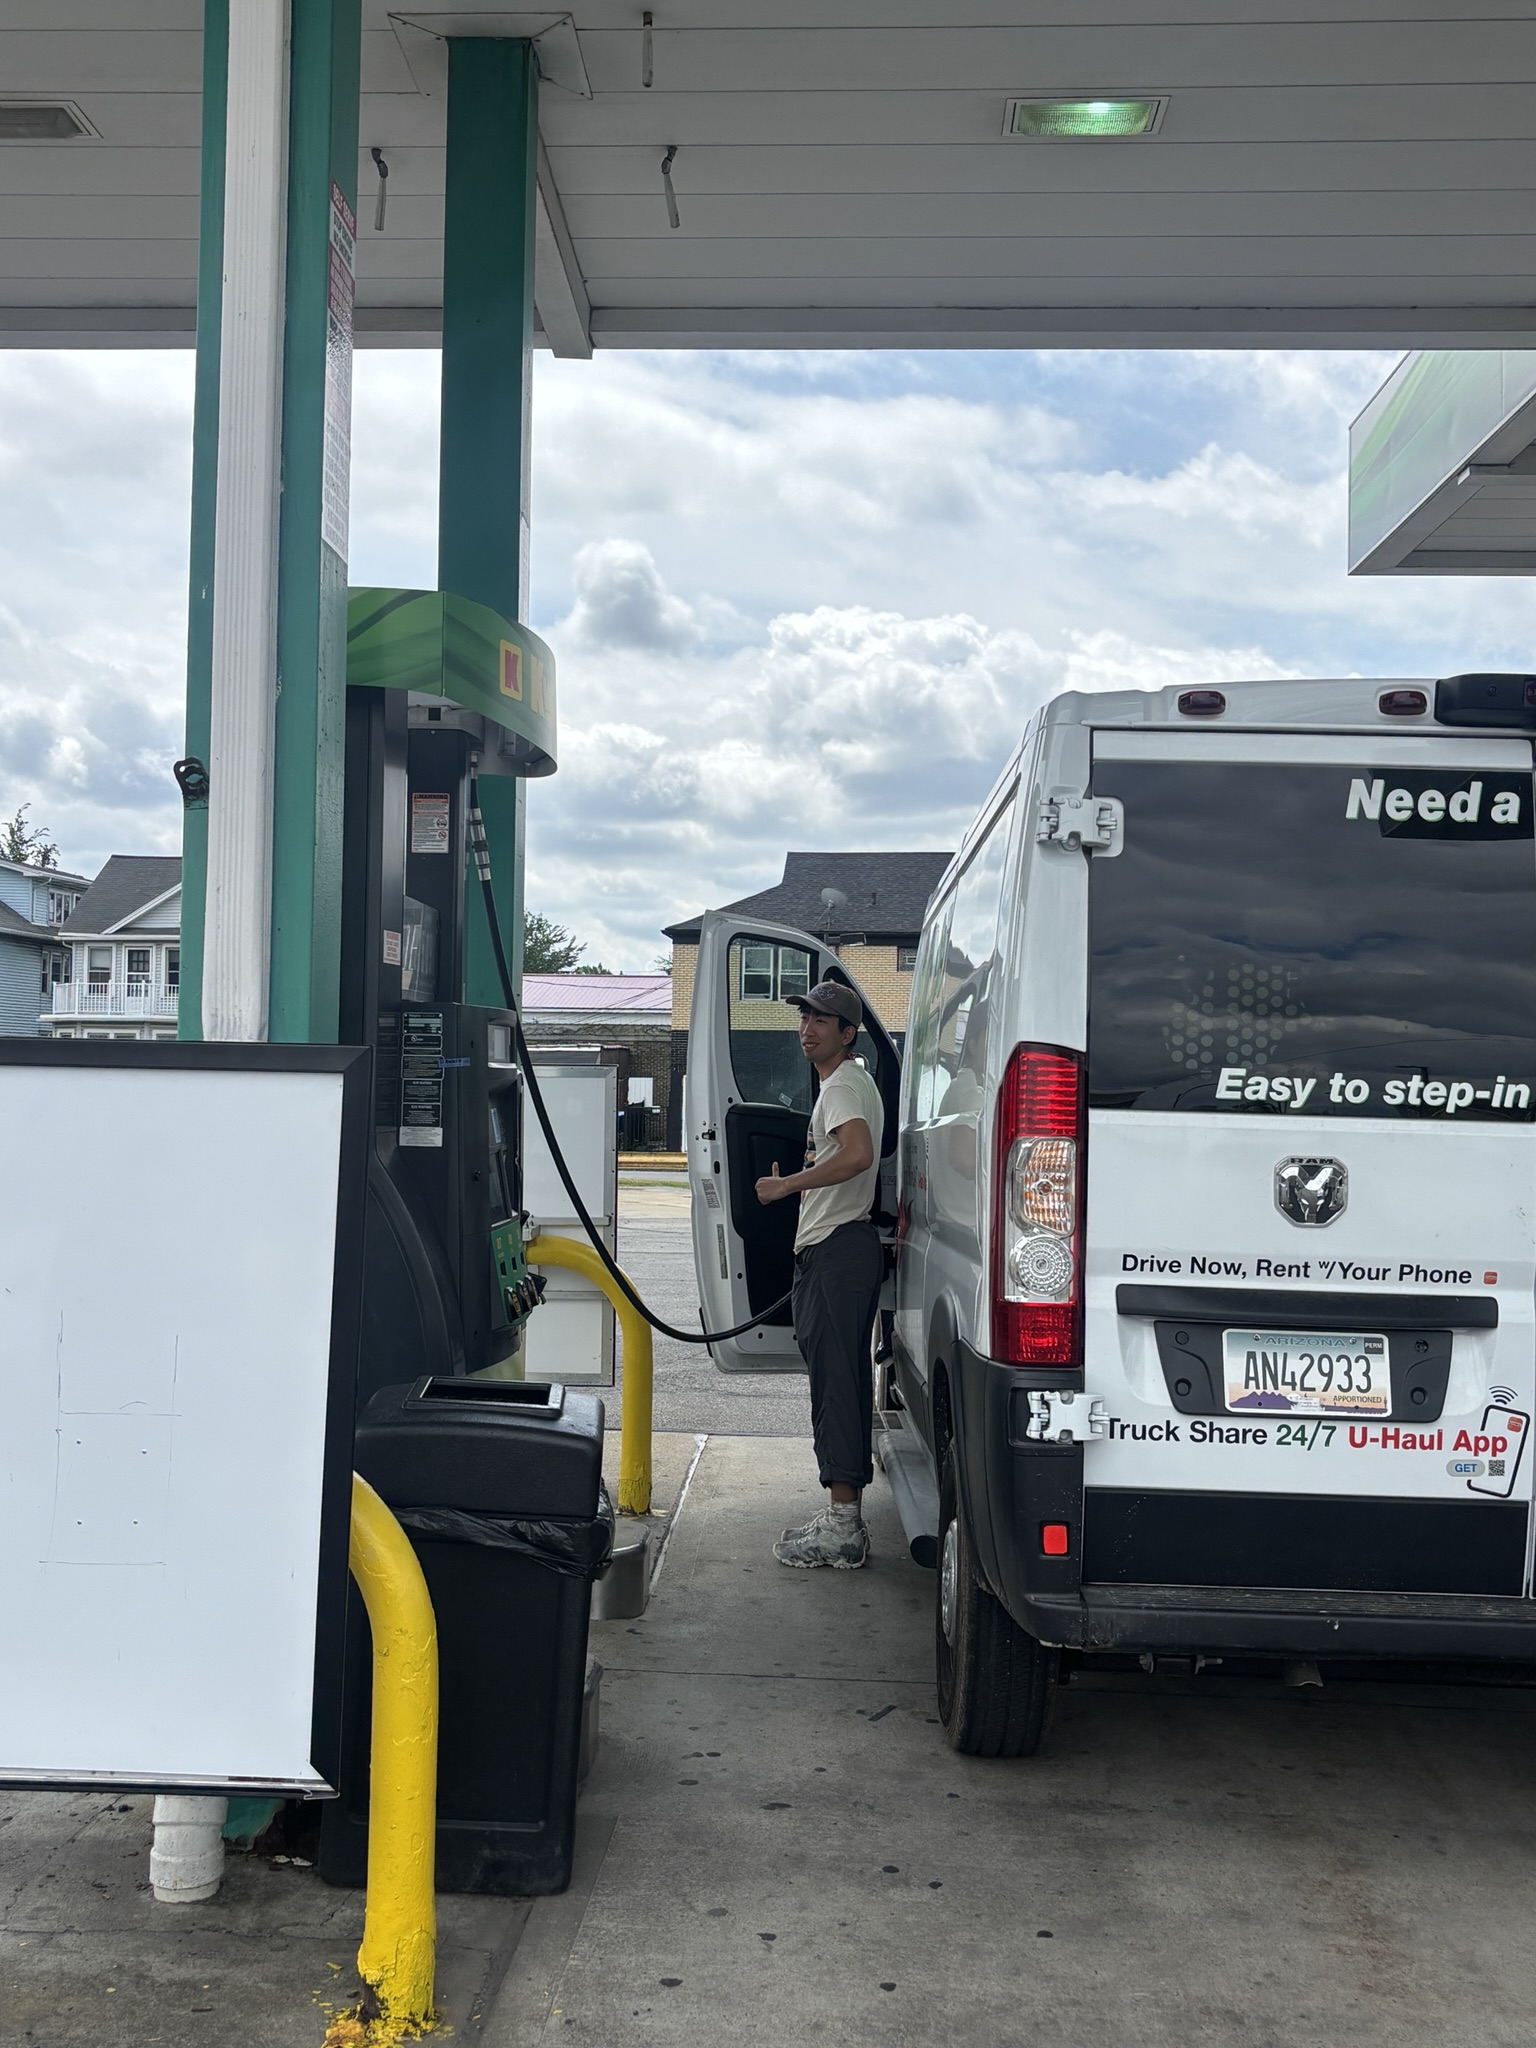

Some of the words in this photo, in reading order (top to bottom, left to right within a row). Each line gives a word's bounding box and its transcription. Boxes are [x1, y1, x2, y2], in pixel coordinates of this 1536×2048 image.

[504, 649, 520, 693] K
[1345, 779, 1483, 824] Need
[1490, 793, 1521, 825] a
[1215, 1067, 1317, 1109] Easy
[1329, 1072, 1370, 1105] to
[1383, 1074, 1531, 1114] step-in
[1122, 1253, 1182, 1274] Drive
[1190, 1256, 1247, 1279] Now,
[1256, 1258, 1311, 1278] Rent
[1398, 1263, 1472, 1284] Phone
[1265, 1335, 1346, 1347] ARIZONA
[1364, 1341, 1383, 1350] PERM
[1244, 1350, 1372, 1393] AN42933
[1333, 1394, 1382, 1404] APPORTIONED
[1109, 1417, 1180, 1442] Truck
[1189, 1420, 1267, 1445] Share
[1276, 1421, 1337, 1451] 24/7
[1348, 1425, 1443, 1451] U-Haul
[1452, 1429, 1508, 1457] App
[1454, 1463, 1477, 1473] GET
